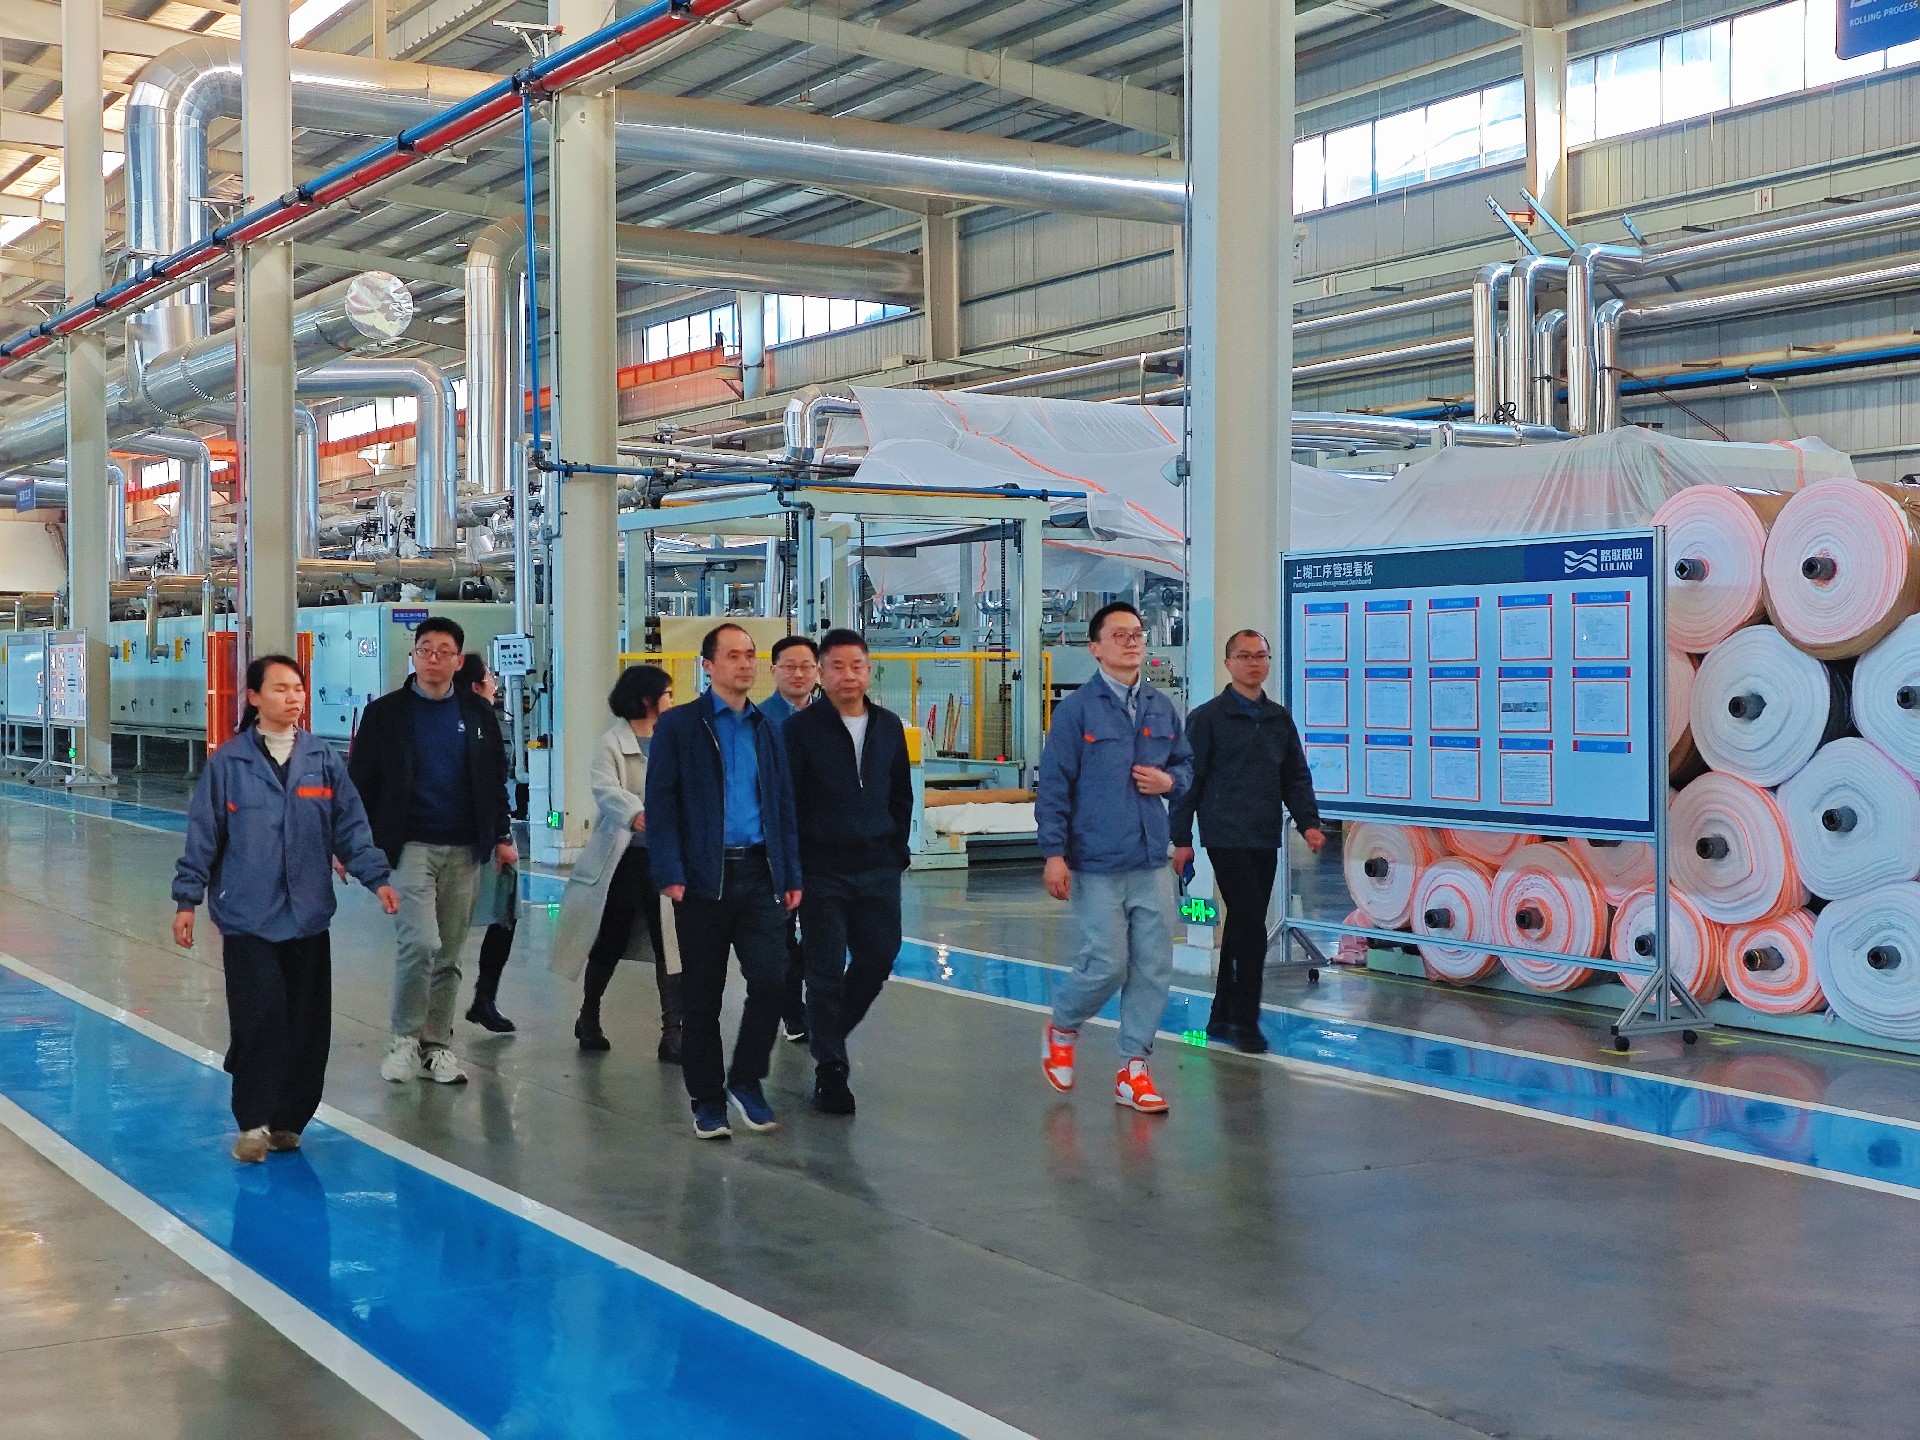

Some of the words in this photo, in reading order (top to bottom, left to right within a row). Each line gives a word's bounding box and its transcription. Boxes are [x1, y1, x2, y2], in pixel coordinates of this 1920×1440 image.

[1849, 11, 1882, 27] ROLLING
[1883, 0, 1919, 17] PROCESS
[1600, 547, 1643, 562] 路联股份
[1292, 561, 1374, 579] 上糊工序管理看板
[1600, 561, 1633, 572] LULIAN
